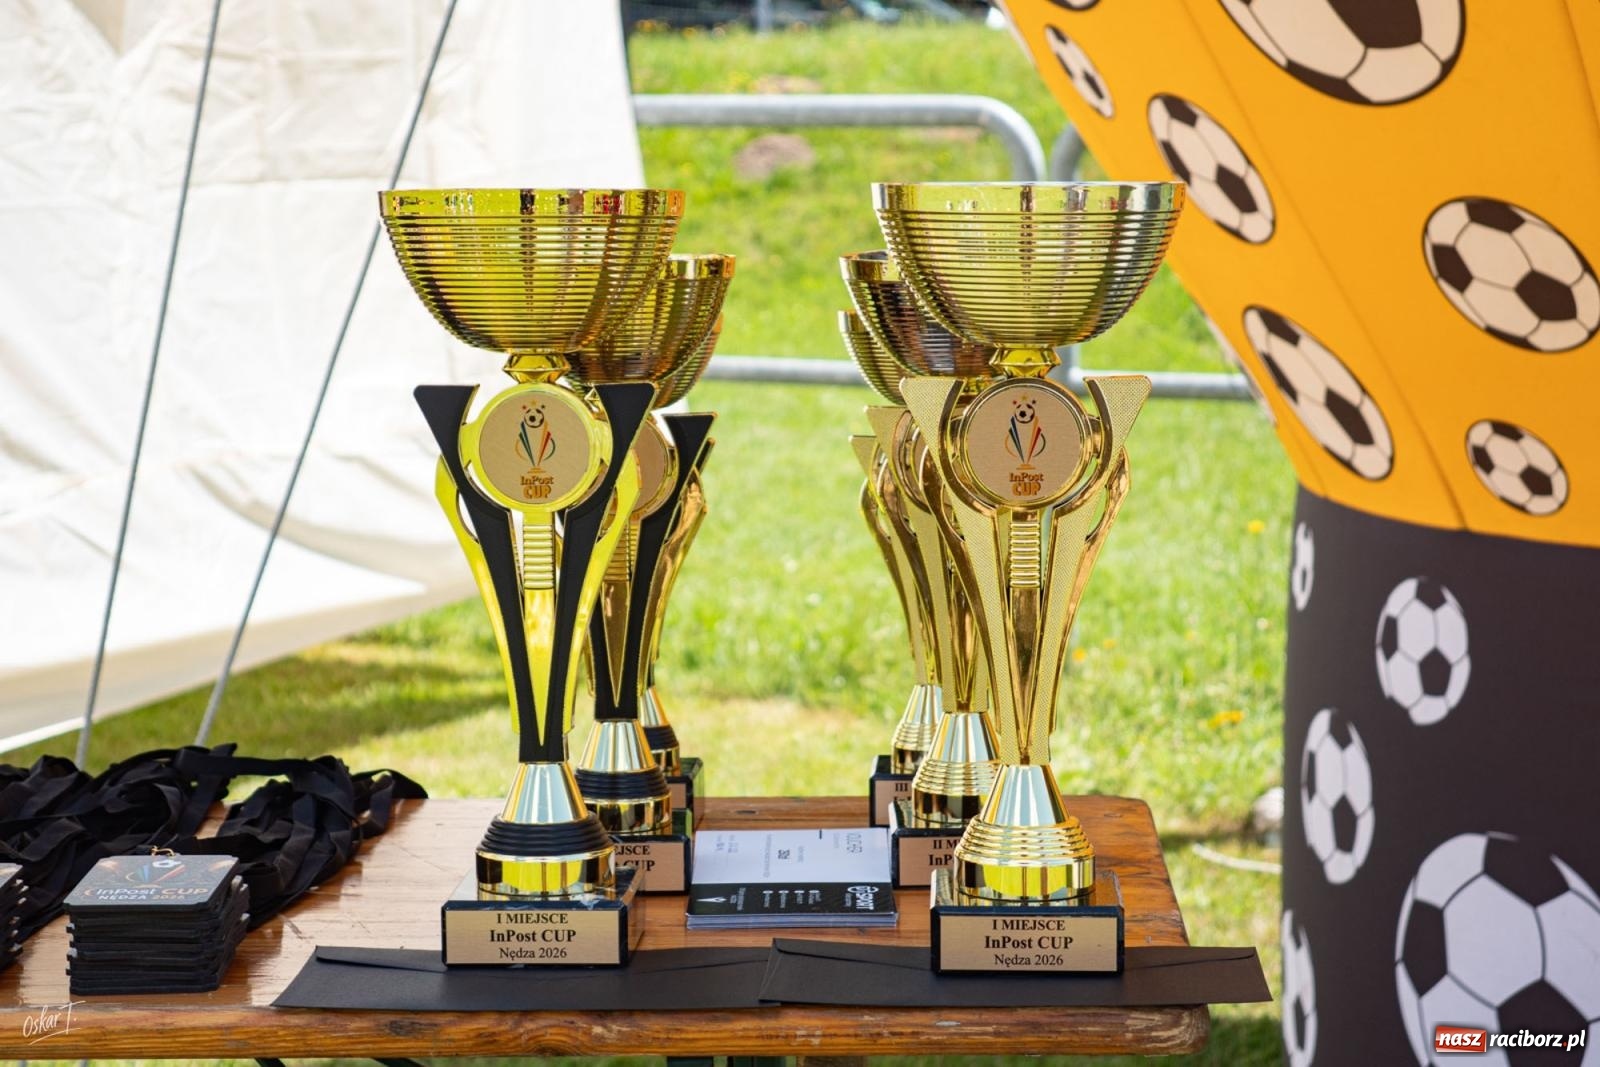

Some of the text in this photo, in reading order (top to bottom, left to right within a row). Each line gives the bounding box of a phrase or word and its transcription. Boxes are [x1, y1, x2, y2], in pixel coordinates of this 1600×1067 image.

[520, 475, 554, 485] InPost
[1009, 472, 1044, 482] InPost
[523, 485, 552, 499] CUP
[1011, 482, 1042, 496] CUP
[895, 783, 908, 792] III
[933, 839, 942, 849] II
[929, 854, 953, 866] InP
[497, 913, 568, 924] I MIEJSCE
[992, 919, 1065, 930] I MIEJSCE
[490, 929, 577, 942] InPost CUP
[984, 935, 1074, 949] InPost CUP
[499, 947, 567, 961] Nędza 2026
[994, 954, 1064, 968] Nędza 2026
